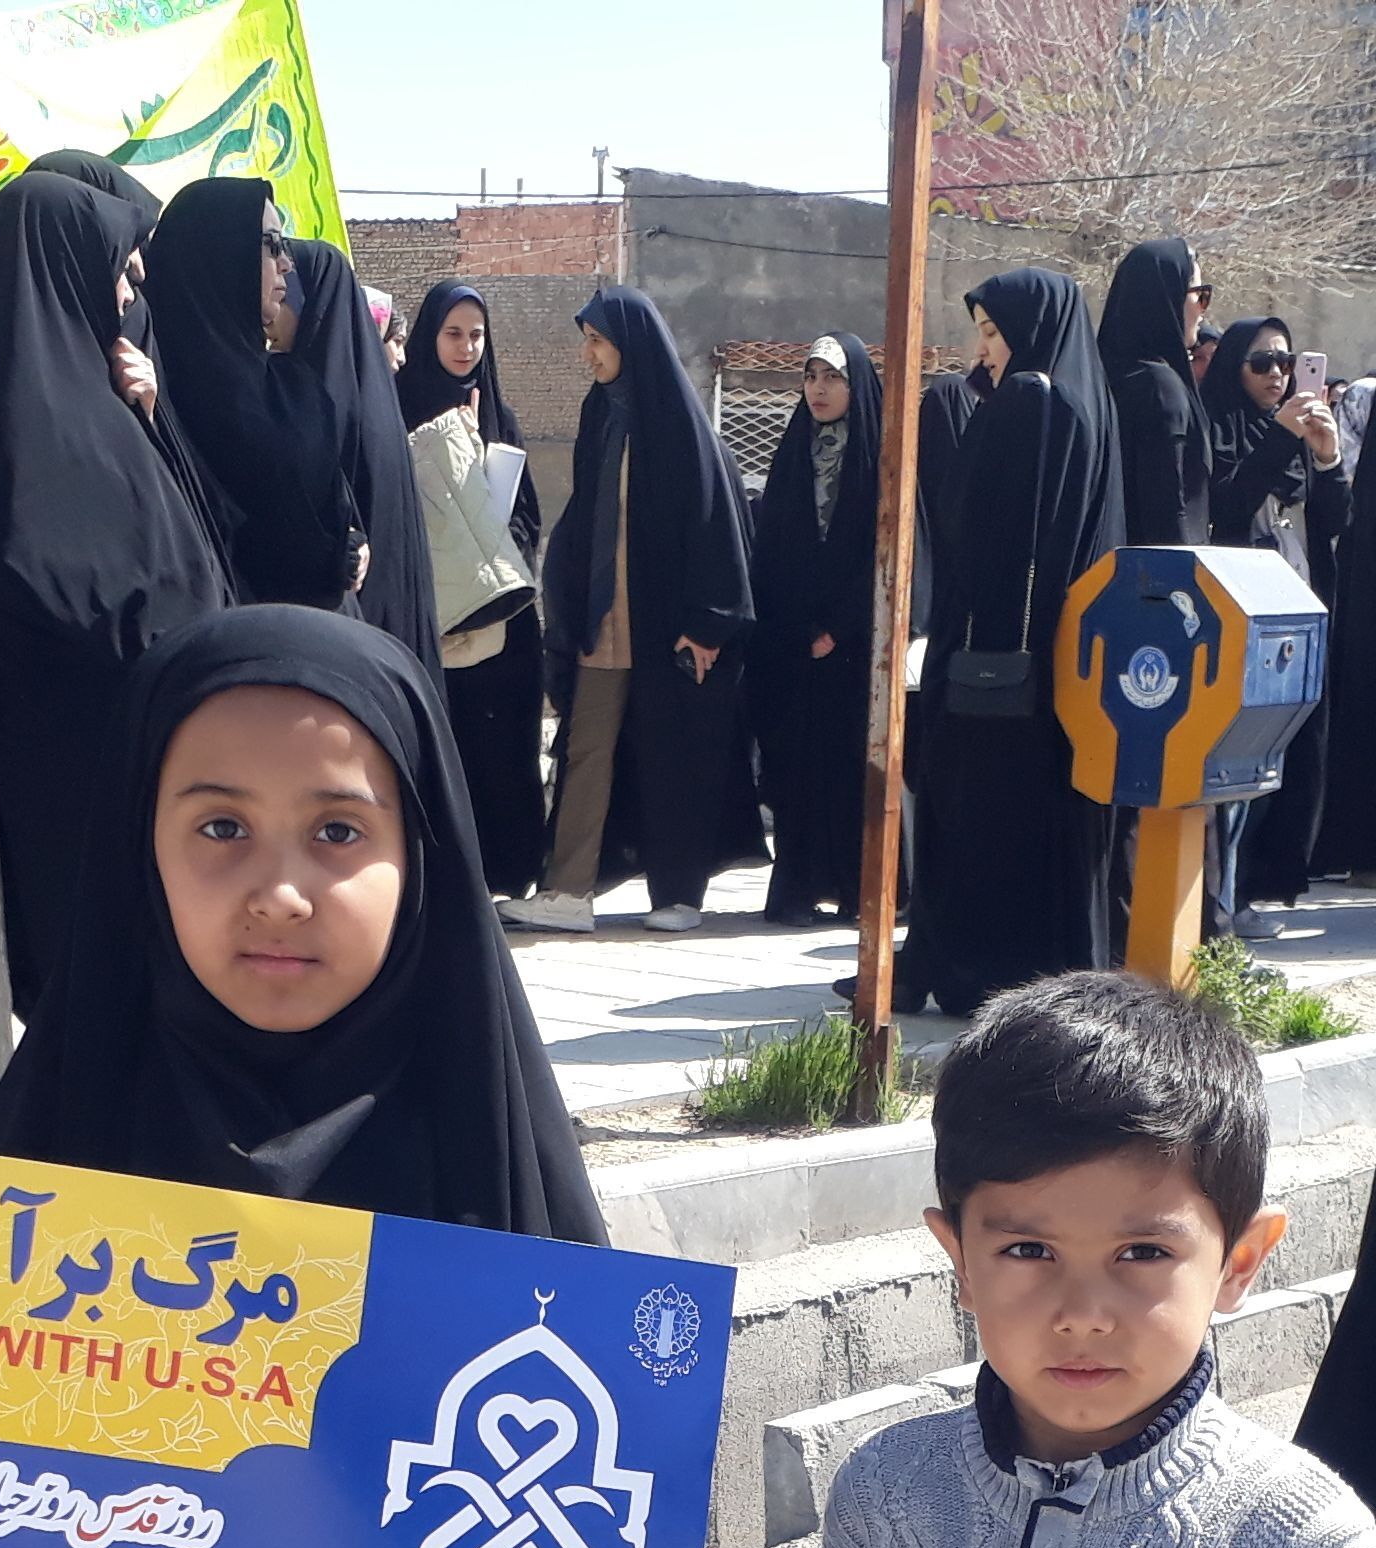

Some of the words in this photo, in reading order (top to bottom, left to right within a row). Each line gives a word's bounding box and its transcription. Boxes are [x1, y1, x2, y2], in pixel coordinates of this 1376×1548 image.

[28, 1236, 114, 1323] بر
[132, 1230, 300, 1346] مرگ
[143, 1346, 295, 1407] U.S.A
[17, 1483, 79, 1521] روز
[76, 1493, 175, 1542] قدس
[156, 1502, 215, 1540] روز
